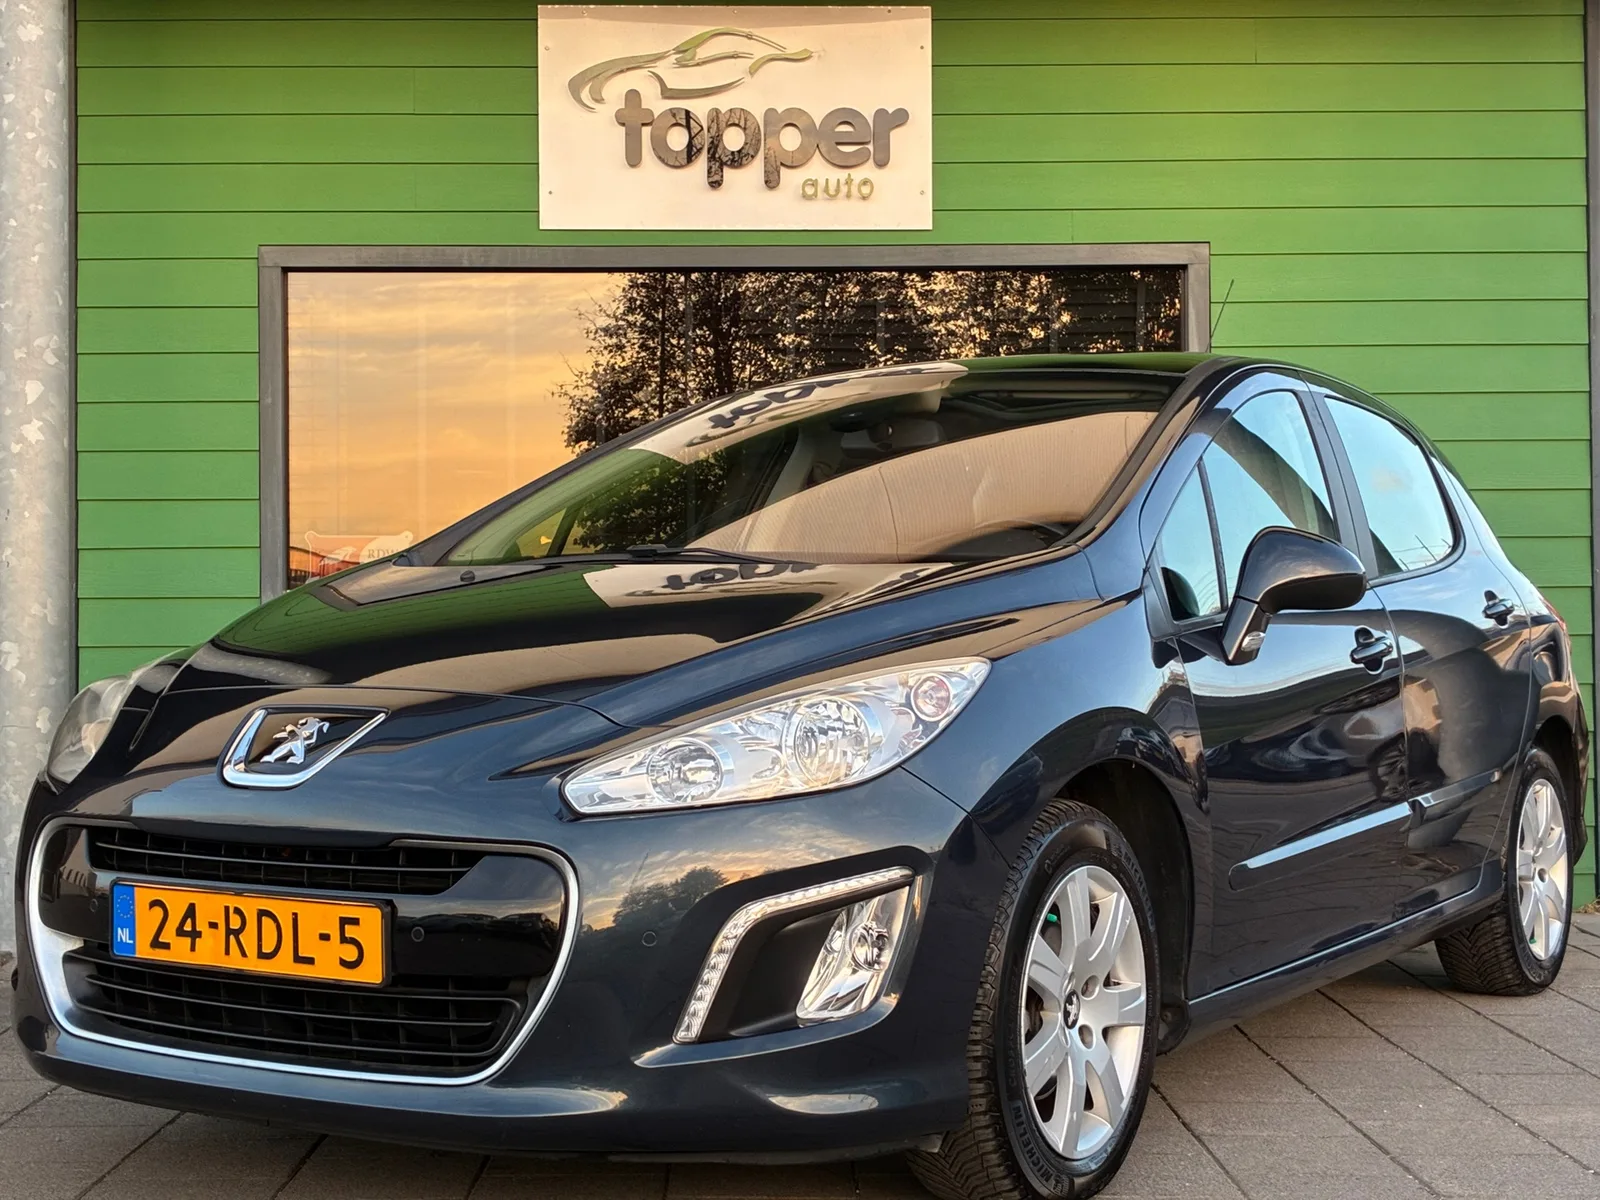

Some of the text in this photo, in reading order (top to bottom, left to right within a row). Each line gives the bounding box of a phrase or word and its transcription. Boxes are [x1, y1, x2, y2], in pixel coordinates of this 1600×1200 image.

[614, 88, 910, 189] topper
[801, 173, 875, 199] auto
[117, 927, 134, 944] NL
[148, 898, 365, 970] 24-RDL-5
[1011, 1105, 1053, 1183] MICHELIN
